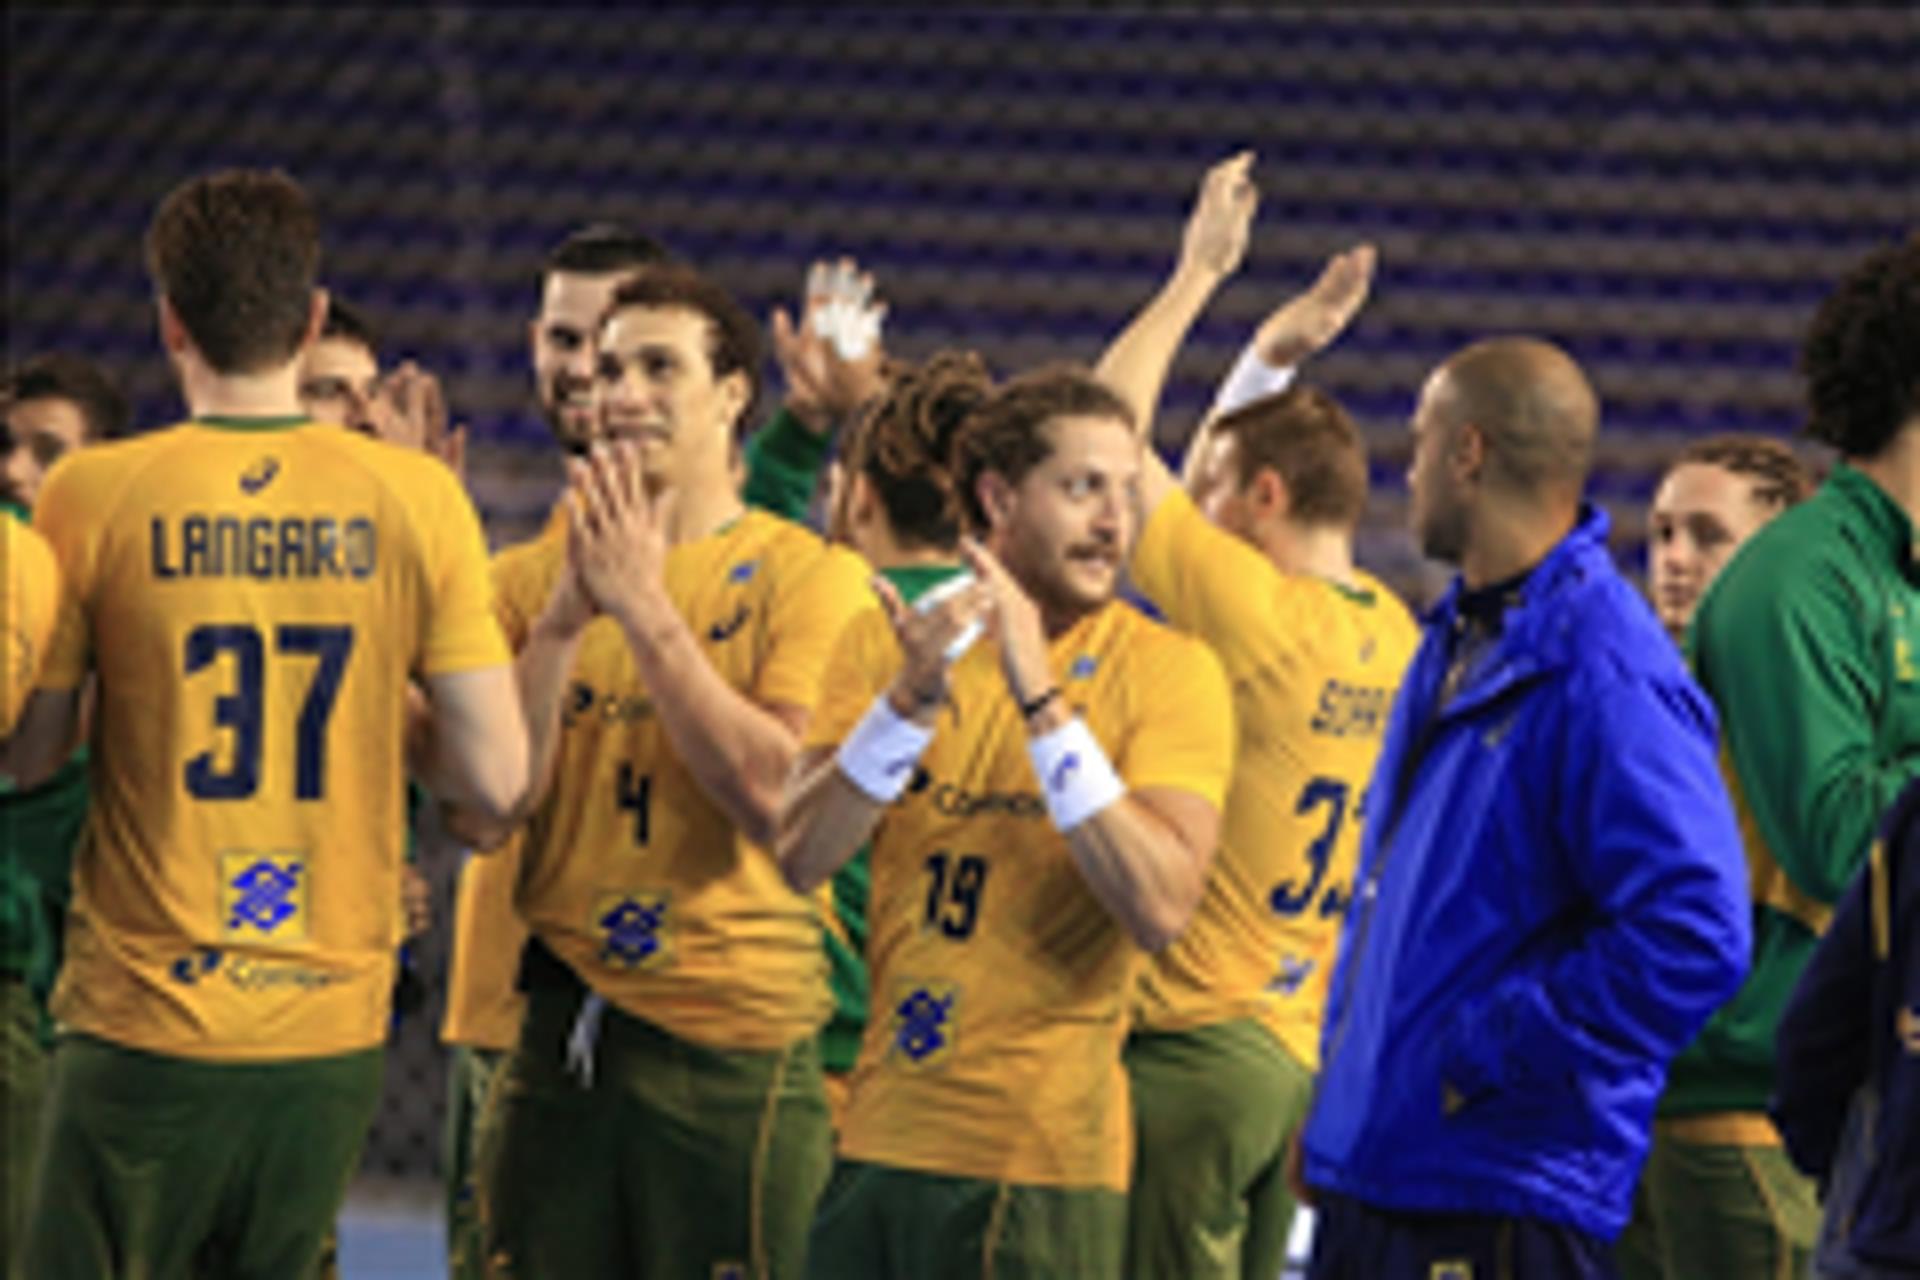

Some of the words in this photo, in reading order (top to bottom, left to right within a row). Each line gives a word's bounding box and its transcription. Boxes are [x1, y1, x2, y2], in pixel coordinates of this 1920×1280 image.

[151, 515, 376, 579] LANGARO
[183, 623, 353, 801] 37
[616, 760, 651, 847] 4
[922, 851, 987, 941] 19
